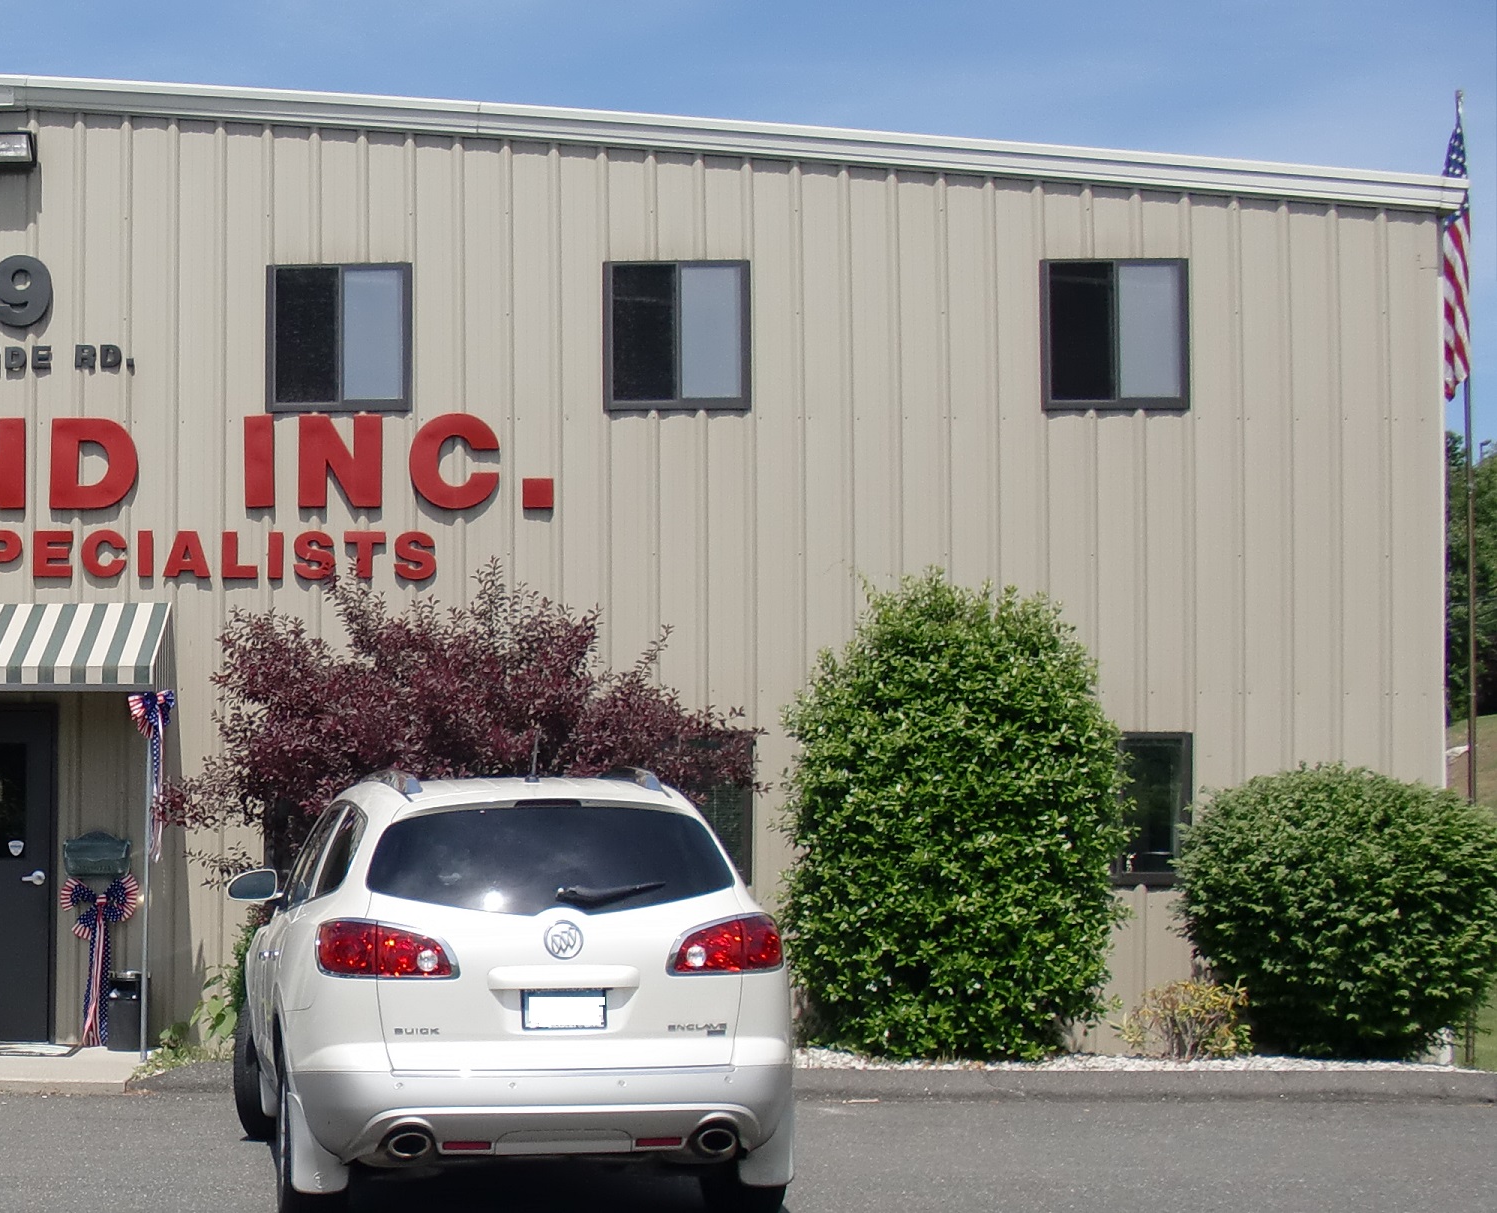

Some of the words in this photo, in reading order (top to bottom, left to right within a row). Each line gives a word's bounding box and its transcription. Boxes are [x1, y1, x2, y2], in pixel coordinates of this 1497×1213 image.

[74, 344, 134, 372] RD.
[243, 413, 555, 510] INC.
[394, 1027, 440, 1036] BUICK
[667, 1022, 727, 1032] ENCLAVE
